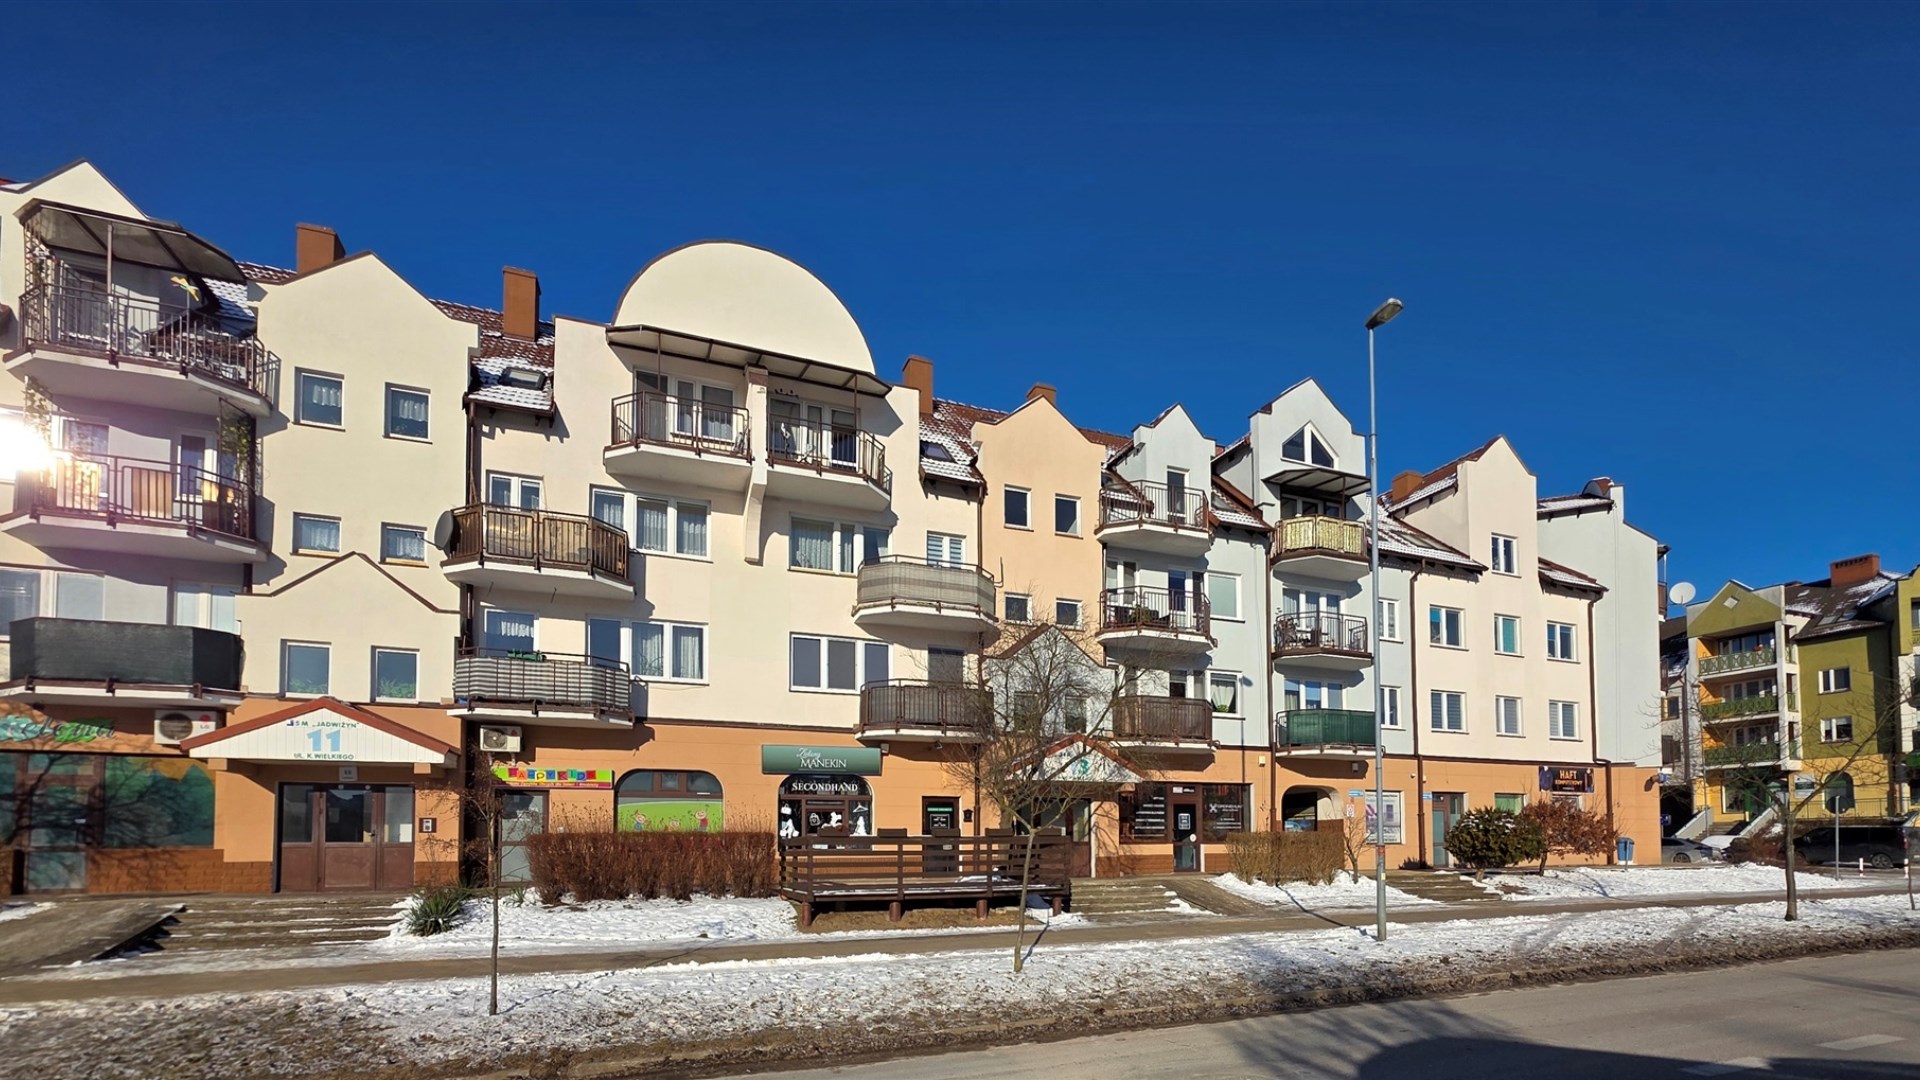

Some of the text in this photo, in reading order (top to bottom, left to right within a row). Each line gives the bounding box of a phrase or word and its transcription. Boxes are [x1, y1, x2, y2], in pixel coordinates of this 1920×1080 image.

[306, 729, 341, 752] 11
[800, 758, 847, 769] MANEKIN
[1559, 769, 1577, 780] HAFT
[791, 781, 859, 793] SECONDHAND
